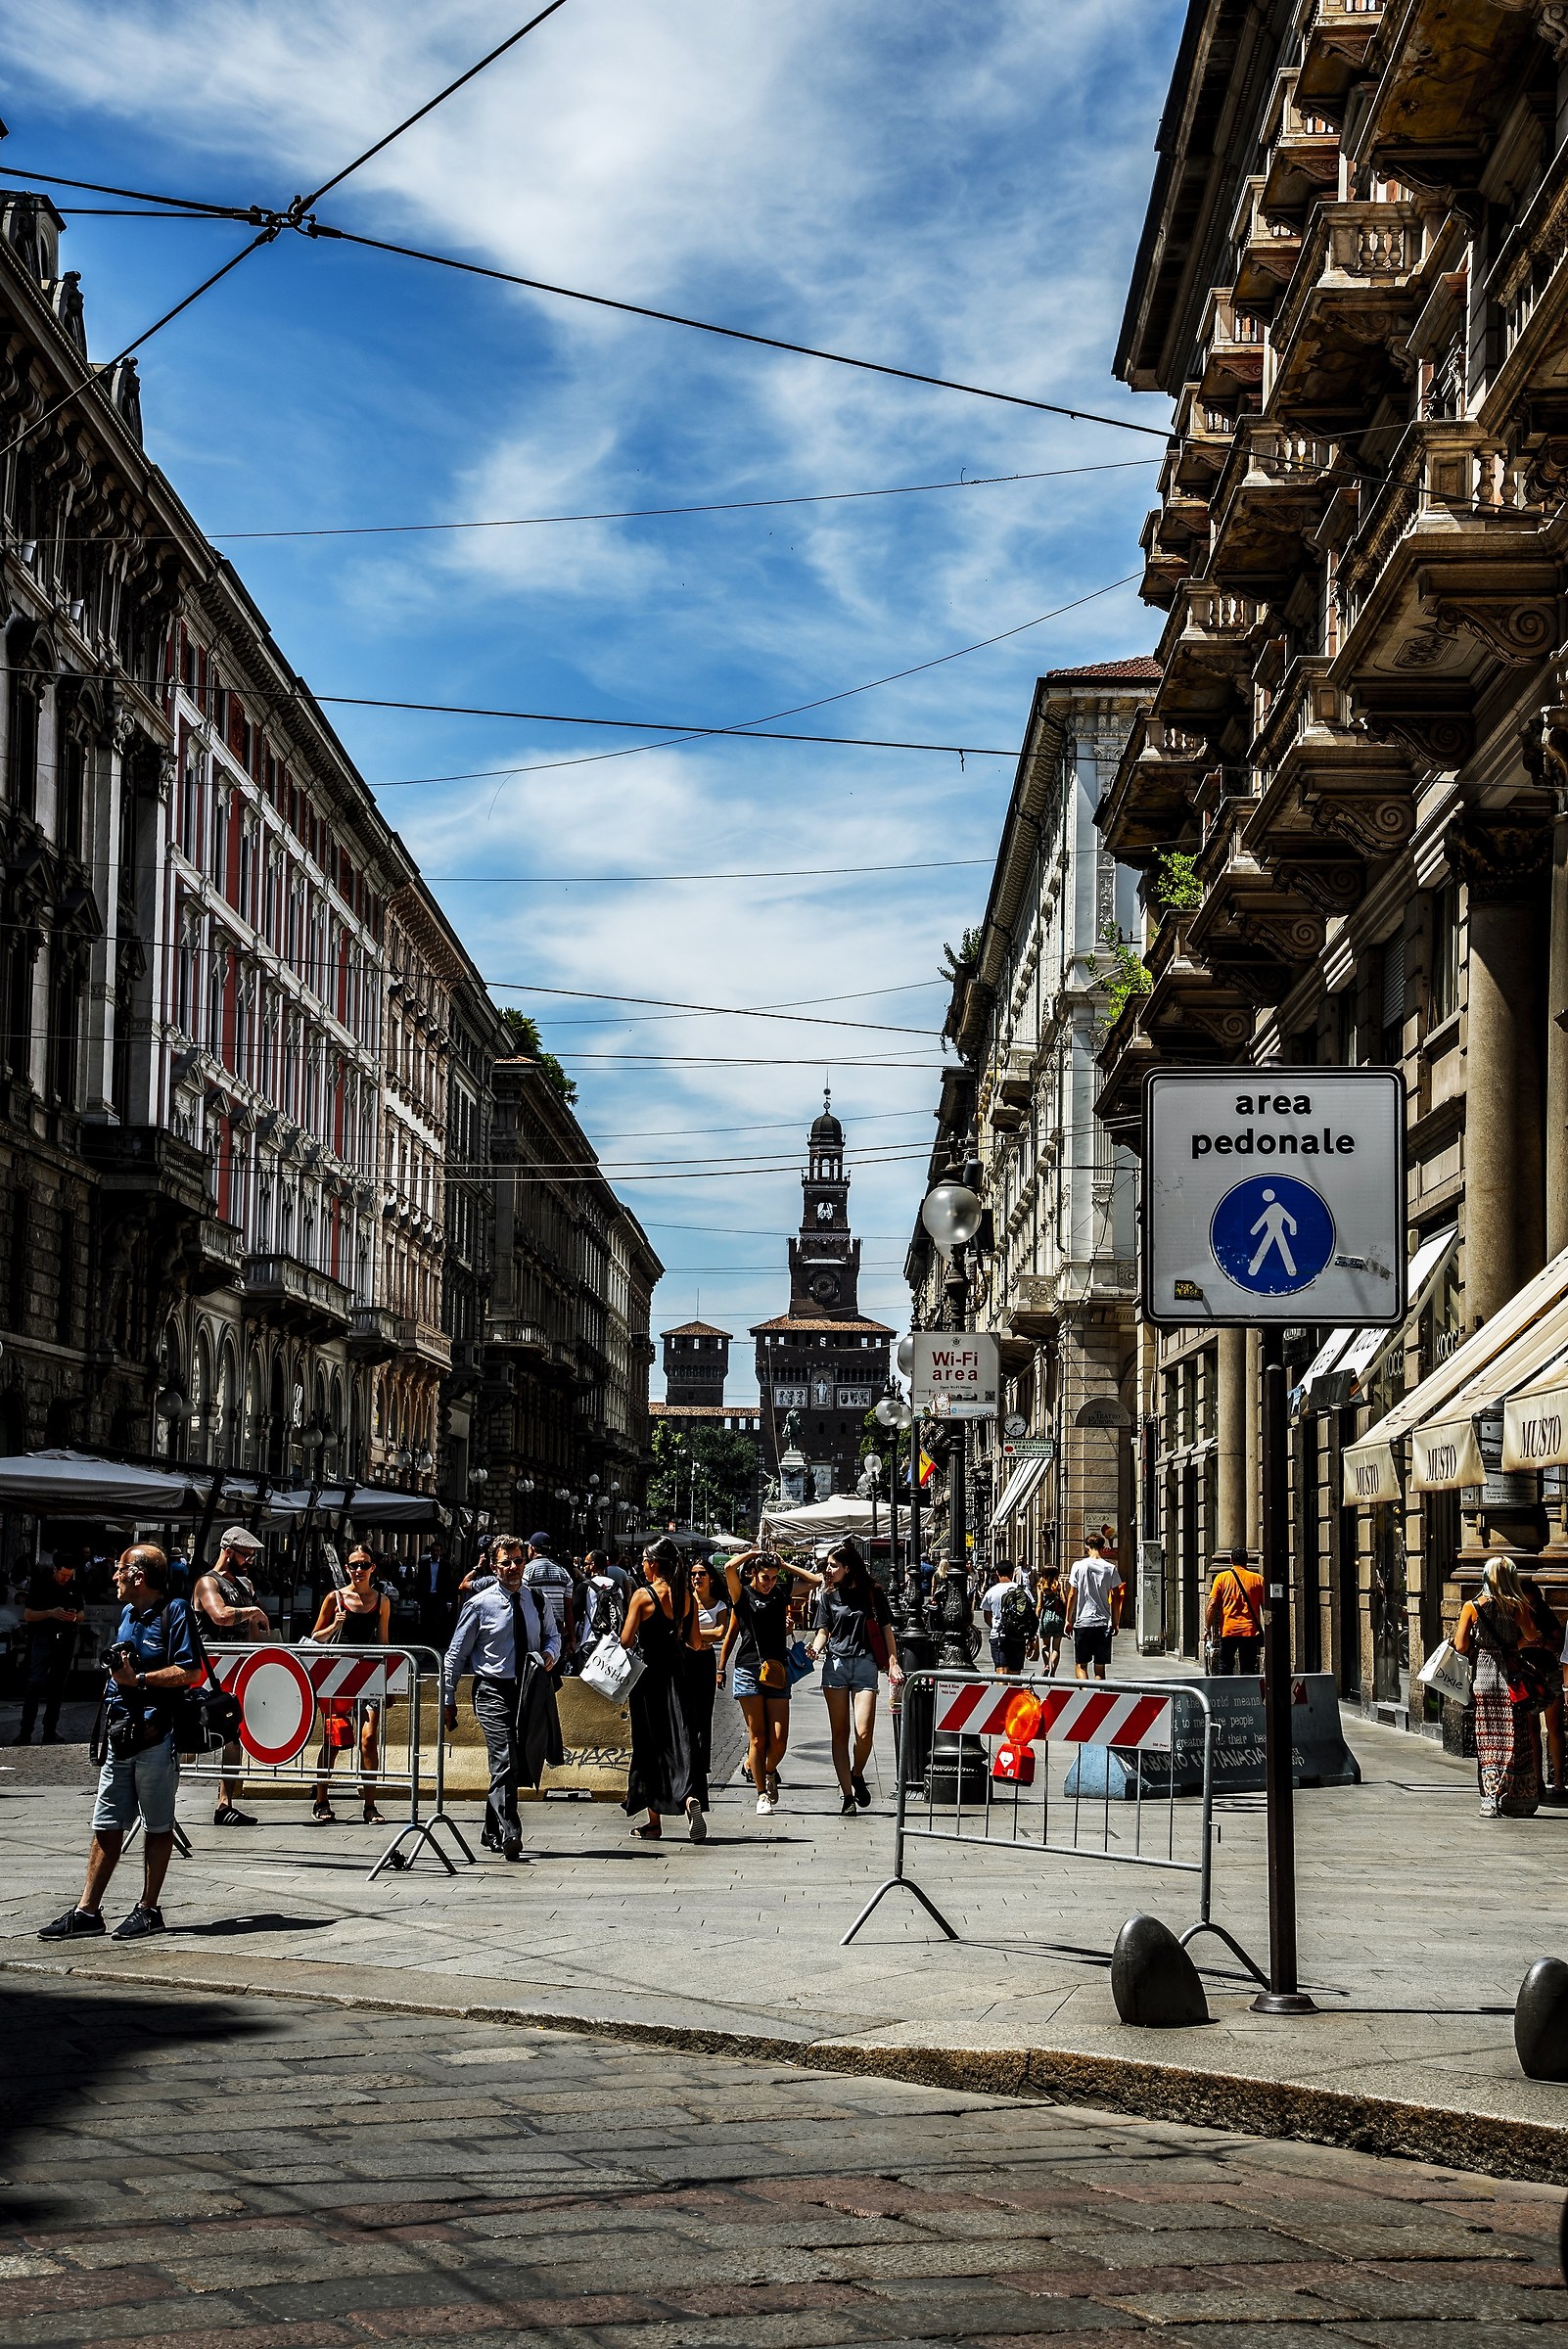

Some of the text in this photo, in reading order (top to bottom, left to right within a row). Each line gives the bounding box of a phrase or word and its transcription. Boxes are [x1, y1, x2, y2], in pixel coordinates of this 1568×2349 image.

[1235, 1094, 1313, 1116] area
[1191, 1128, 1356, 1160] pedonale
[1436, 1329, 1460, 1362] KOCC
[932, 1351, 978, 1366] Wi-Fi
[1384, 1350, 1406, 1379] KOCC
[932, 1369, 978, 1381] area
[1088, 1416, 1115, 1425] EUROPA
[1094, 1410, 1121, 1419] TEATRO
[1520, 1415, 1561, 1458] MUSTO
[1426, 1444, 1457, 1481] MUSTO
[1355, 1463, 1379, 1496] MUSTO
[592, 1655, 630, 1686] OYSHO
[1186, 1696, 1200, 1708] the
[1234, 1695, 1261, 1707] means
[1182, 1718, 1190, 1728] to
[1230, 1715, 1254, 1728] people
[1176, 1737, 1205, 1751] greatne
[1227, 1733, 1248, 1745] their
[1254, 1734, 1267, 1744] hea
[1141, 1752, 1188, 1773] ABORTO
